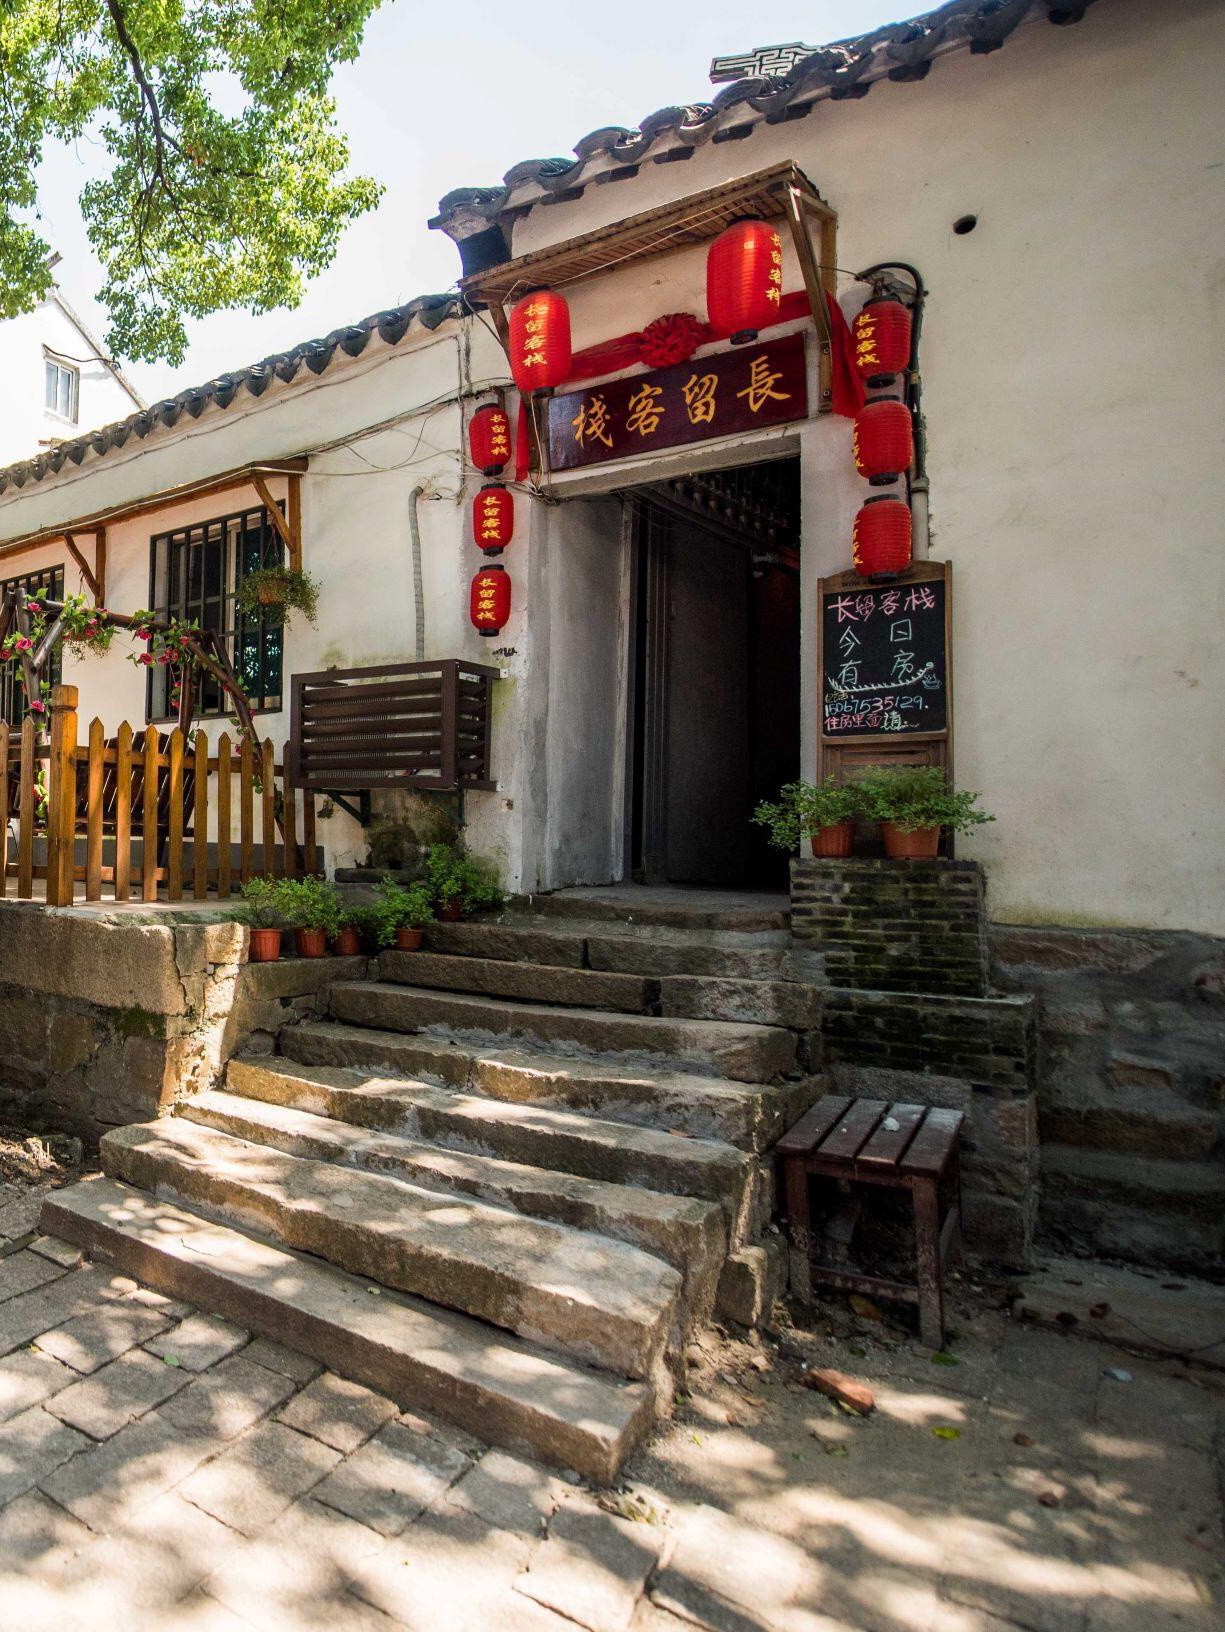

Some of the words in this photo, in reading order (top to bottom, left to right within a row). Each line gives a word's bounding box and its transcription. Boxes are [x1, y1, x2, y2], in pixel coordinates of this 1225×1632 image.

[522, 303, 548, 367] 长留客栈
[856, 313, 880, 366] 长留客栈
[827, 587, 936, 623] 长留客栈
